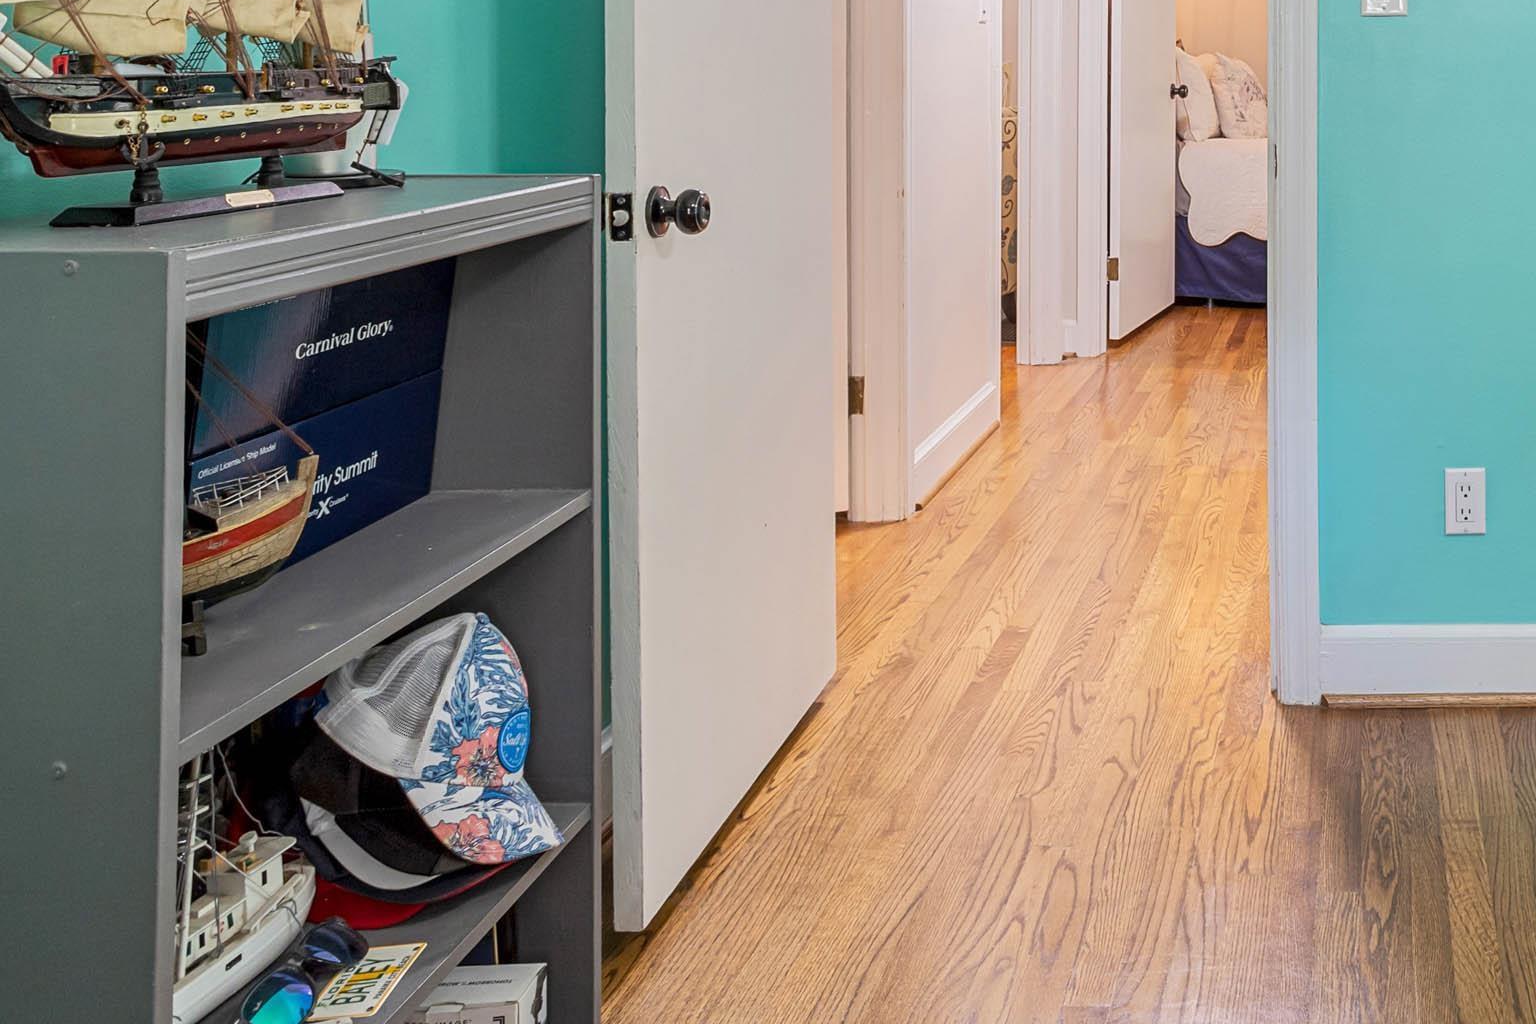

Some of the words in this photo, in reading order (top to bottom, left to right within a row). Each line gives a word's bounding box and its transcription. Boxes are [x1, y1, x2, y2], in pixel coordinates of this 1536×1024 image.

[295, 327, 355, 360] Carnival
[198, 464, 219, 479] Official
[246, 451, 259, 460] Ship
[259, 442, 277, 455] Model
[334, 450, 378, 486] Summit
[329, 958, 397, 1006] BAILEY
